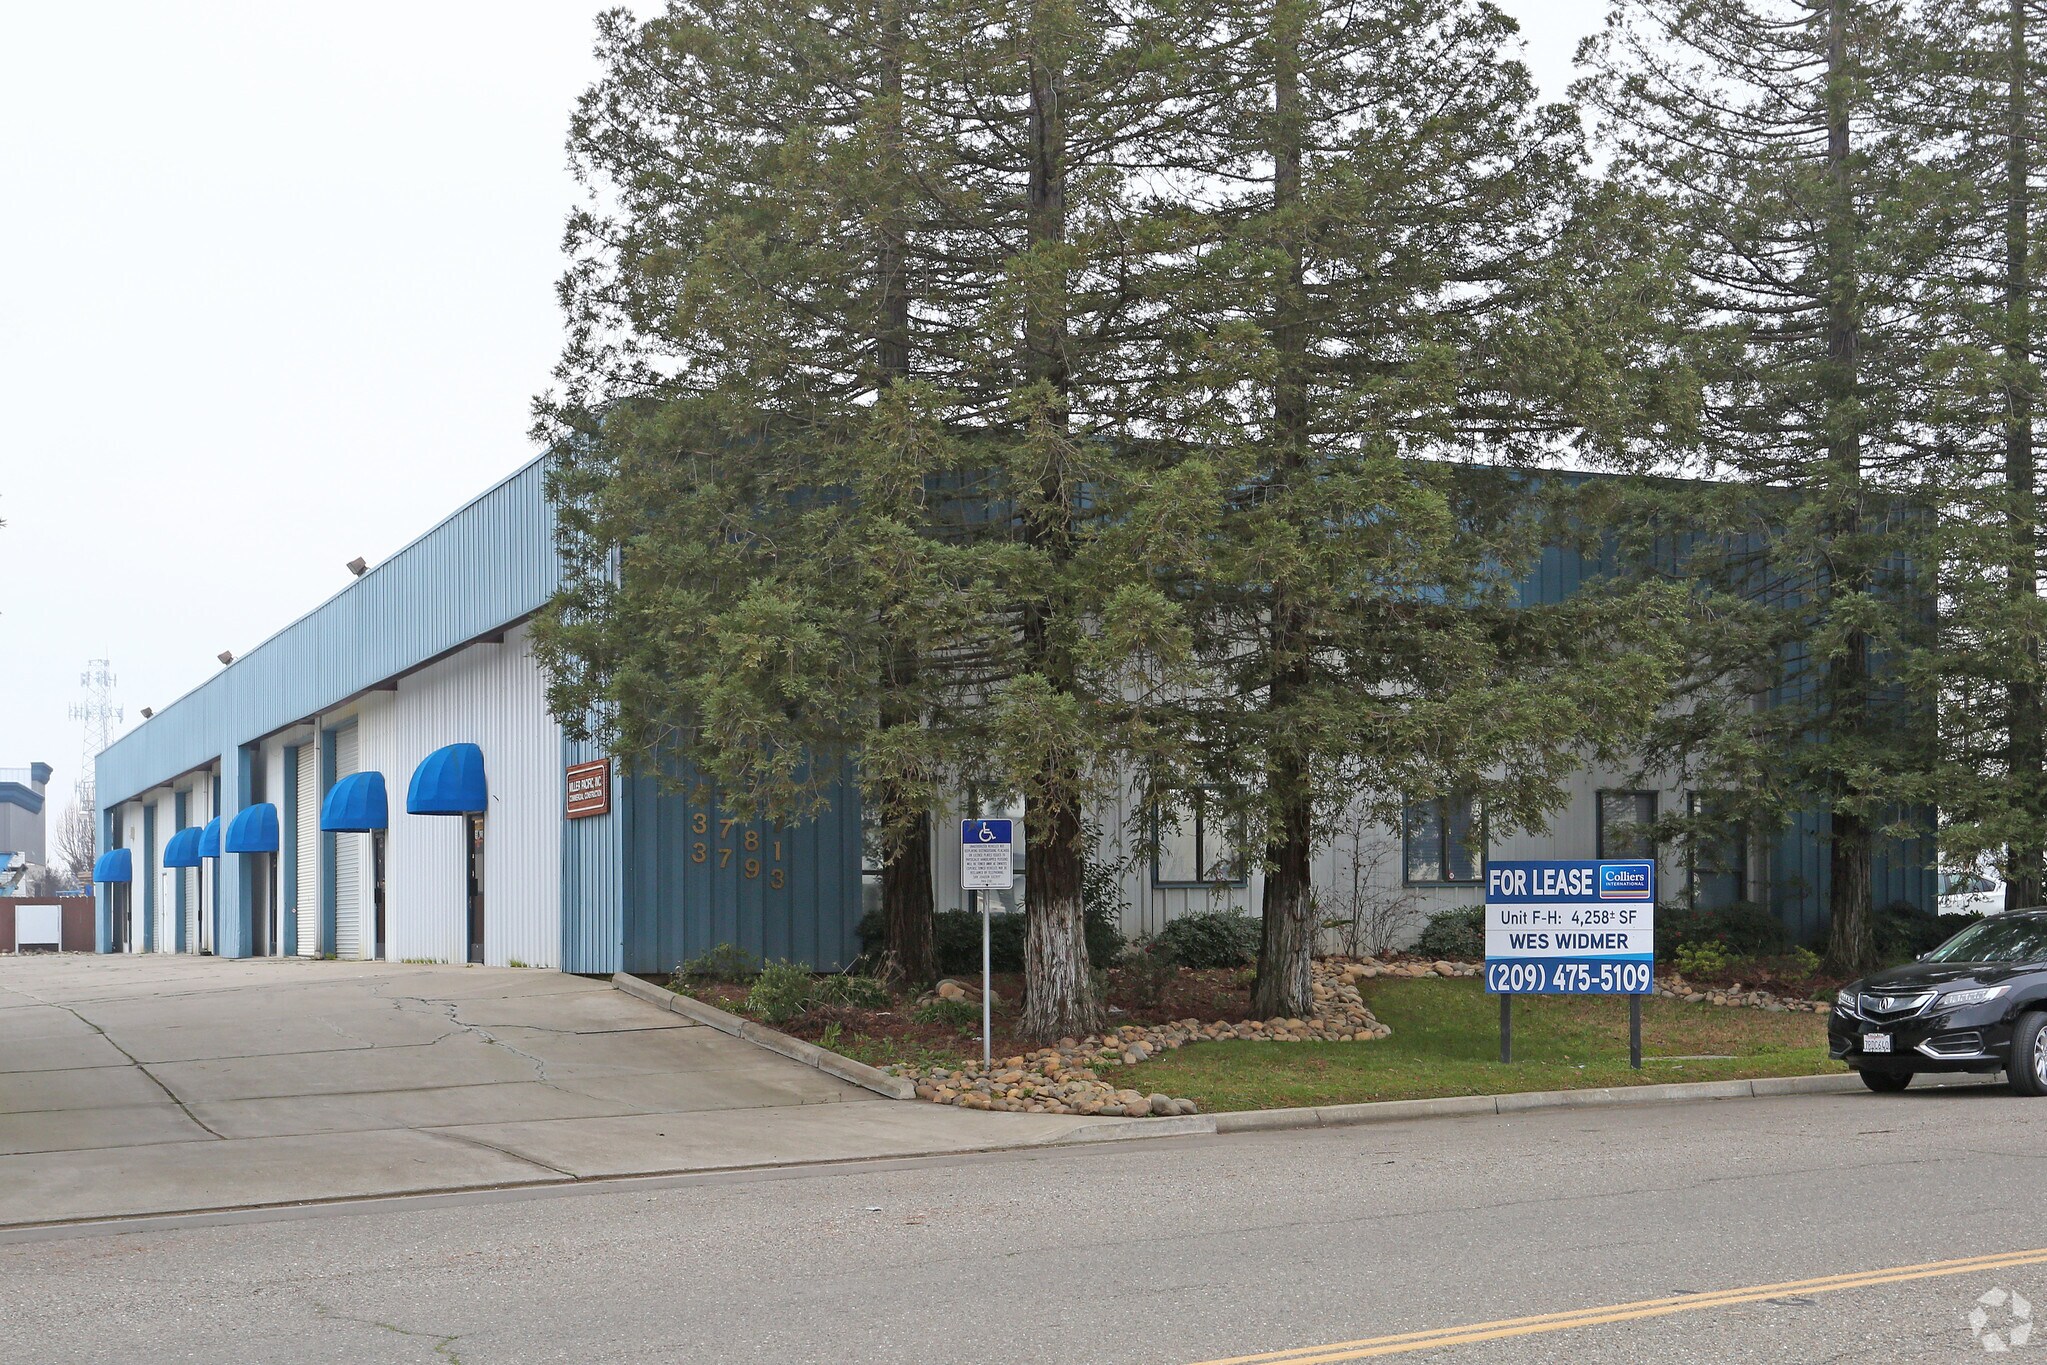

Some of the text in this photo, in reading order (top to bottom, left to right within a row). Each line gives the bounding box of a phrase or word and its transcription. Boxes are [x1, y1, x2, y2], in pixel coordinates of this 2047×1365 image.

[692, 813, 782, 862] 3781
[691, 842, 785, 890] 3793
[1605, 870, 1645, 881] Colliers
[1489, 868, 1593, 896] FOR LEASE
[1501, 910, 1528, 925] Unit
[1532, 910, 1562, 925] F-H:
[1619, 910, 1637, 925] SF
[1509, 933, 1629, 949] WES WIDMER
[1488, 963, 1650, 992] (209) 475-5109
